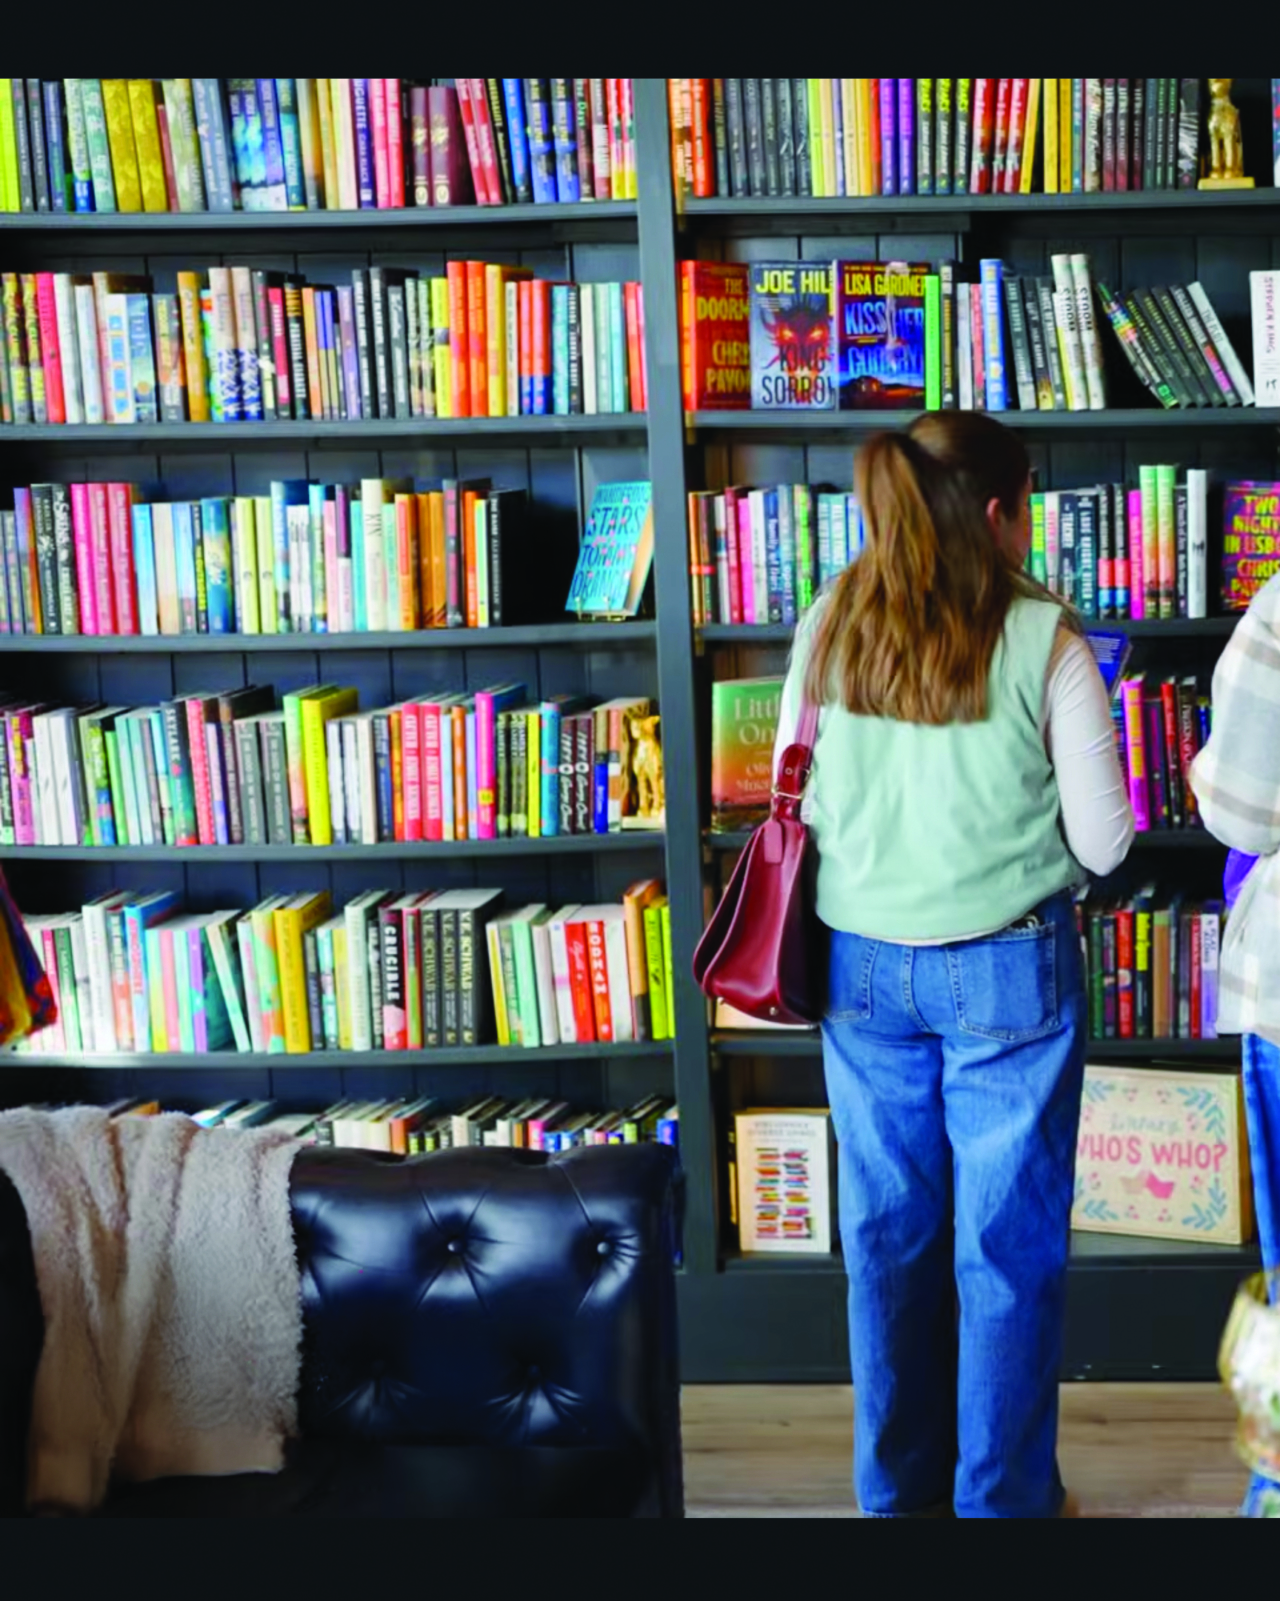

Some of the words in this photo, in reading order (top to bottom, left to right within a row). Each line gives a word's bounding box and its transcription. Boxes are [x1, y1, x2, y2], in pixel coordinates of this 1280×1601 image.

[352, 79, 369, 130] UGUETTE
[755, 270, 795, 293] JOE
[845, 273, 872, 296] LISA
[845, 302, 887, 334] KISS
[587, 504, 646, 537] STARS
[1243, 495, 1280, 515] TWO
[1225, 536, 1241, 553] IN
[734, 693, 779, 721] Littl
[165, 709, 181, 762] SKYLARK
[561, 733, 573, 761] 1984
[577, 731, 588, 760] 1984
[739, 722, 775, 745] On
[383, 926, 400, 1001] CRUCIBLE
[424, 938, 438, 991] SCHWAB
[443, 937, 456, 990] SCHWAB
[460, 936, 473, 989] SCHWAB
[1151, 1140, 1228, 1173] WHO?
